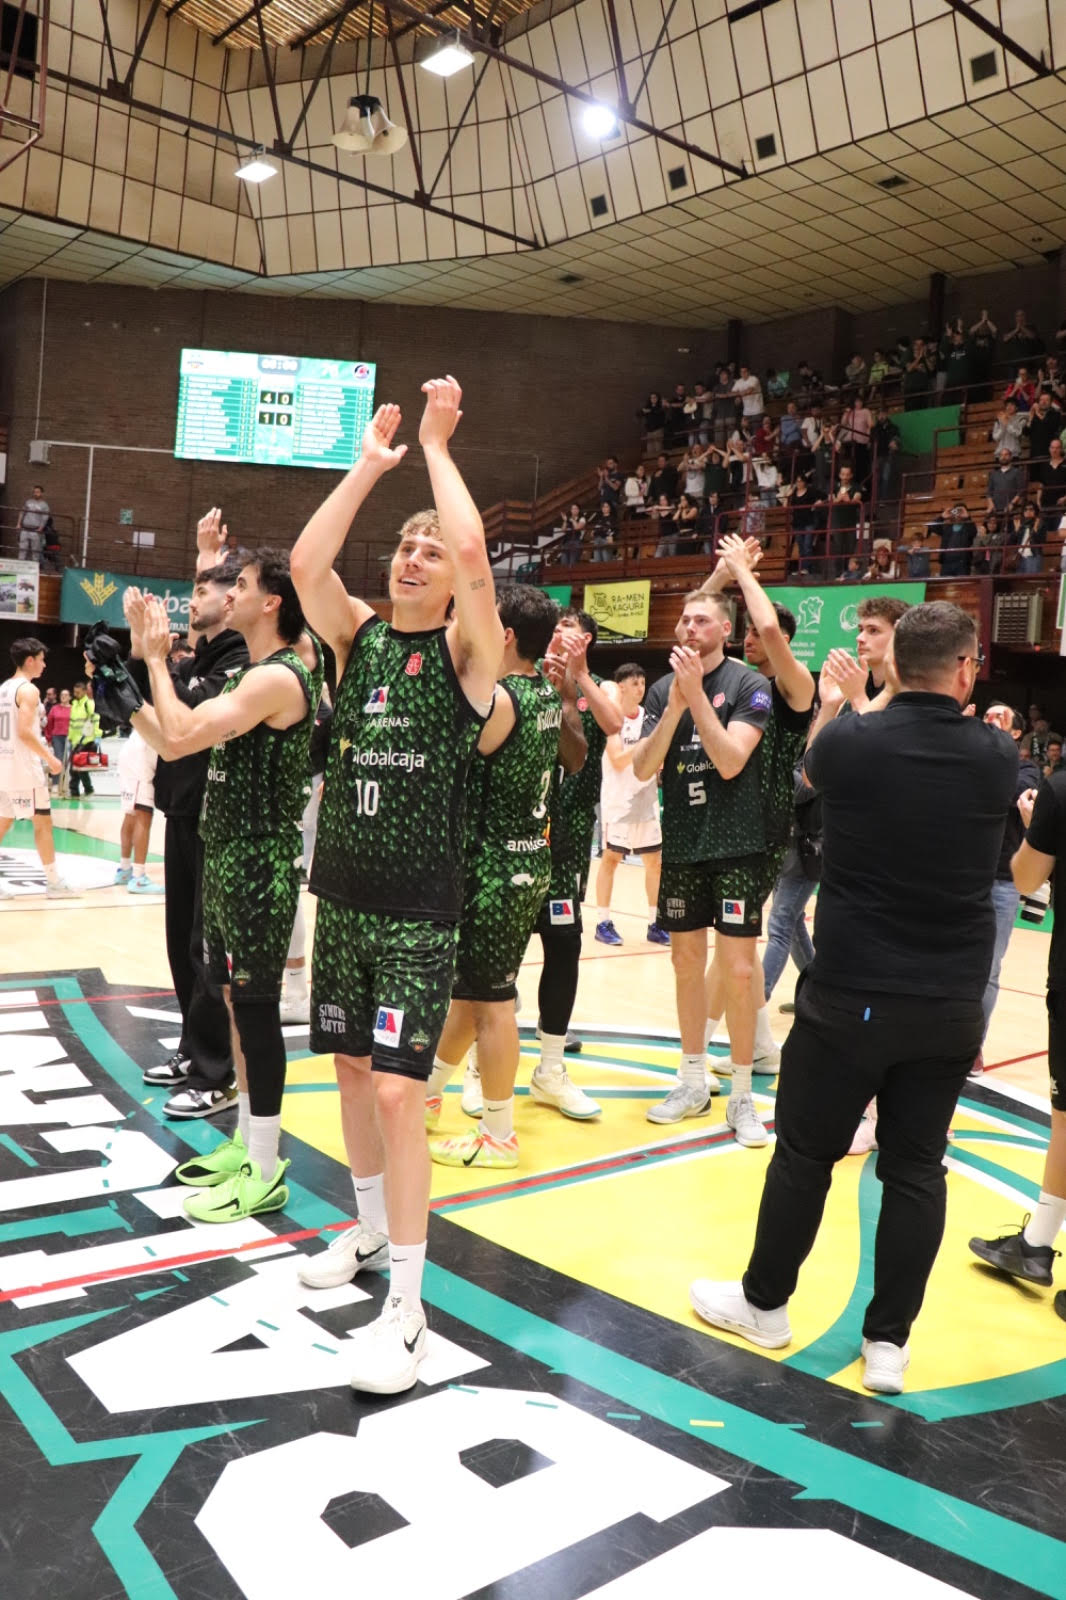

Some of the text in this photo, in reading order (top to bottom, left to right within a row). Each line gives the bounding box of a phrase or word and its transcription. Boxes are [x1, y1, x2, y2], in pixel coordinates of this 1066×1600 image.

[263, 393, 290, 405] 4 0
[279, 414, 288, 425] 0
[370, 717, 410, 728] ARENAS
[686, 760, 716, 773] Globalc
[355, 779, 380, 816] 10
[688, 781, 707, 807] 5
[552, 902, 571, 915] BA
[724, 902, 742, 915] BA
[377, 1011, 397, 1033] BA
